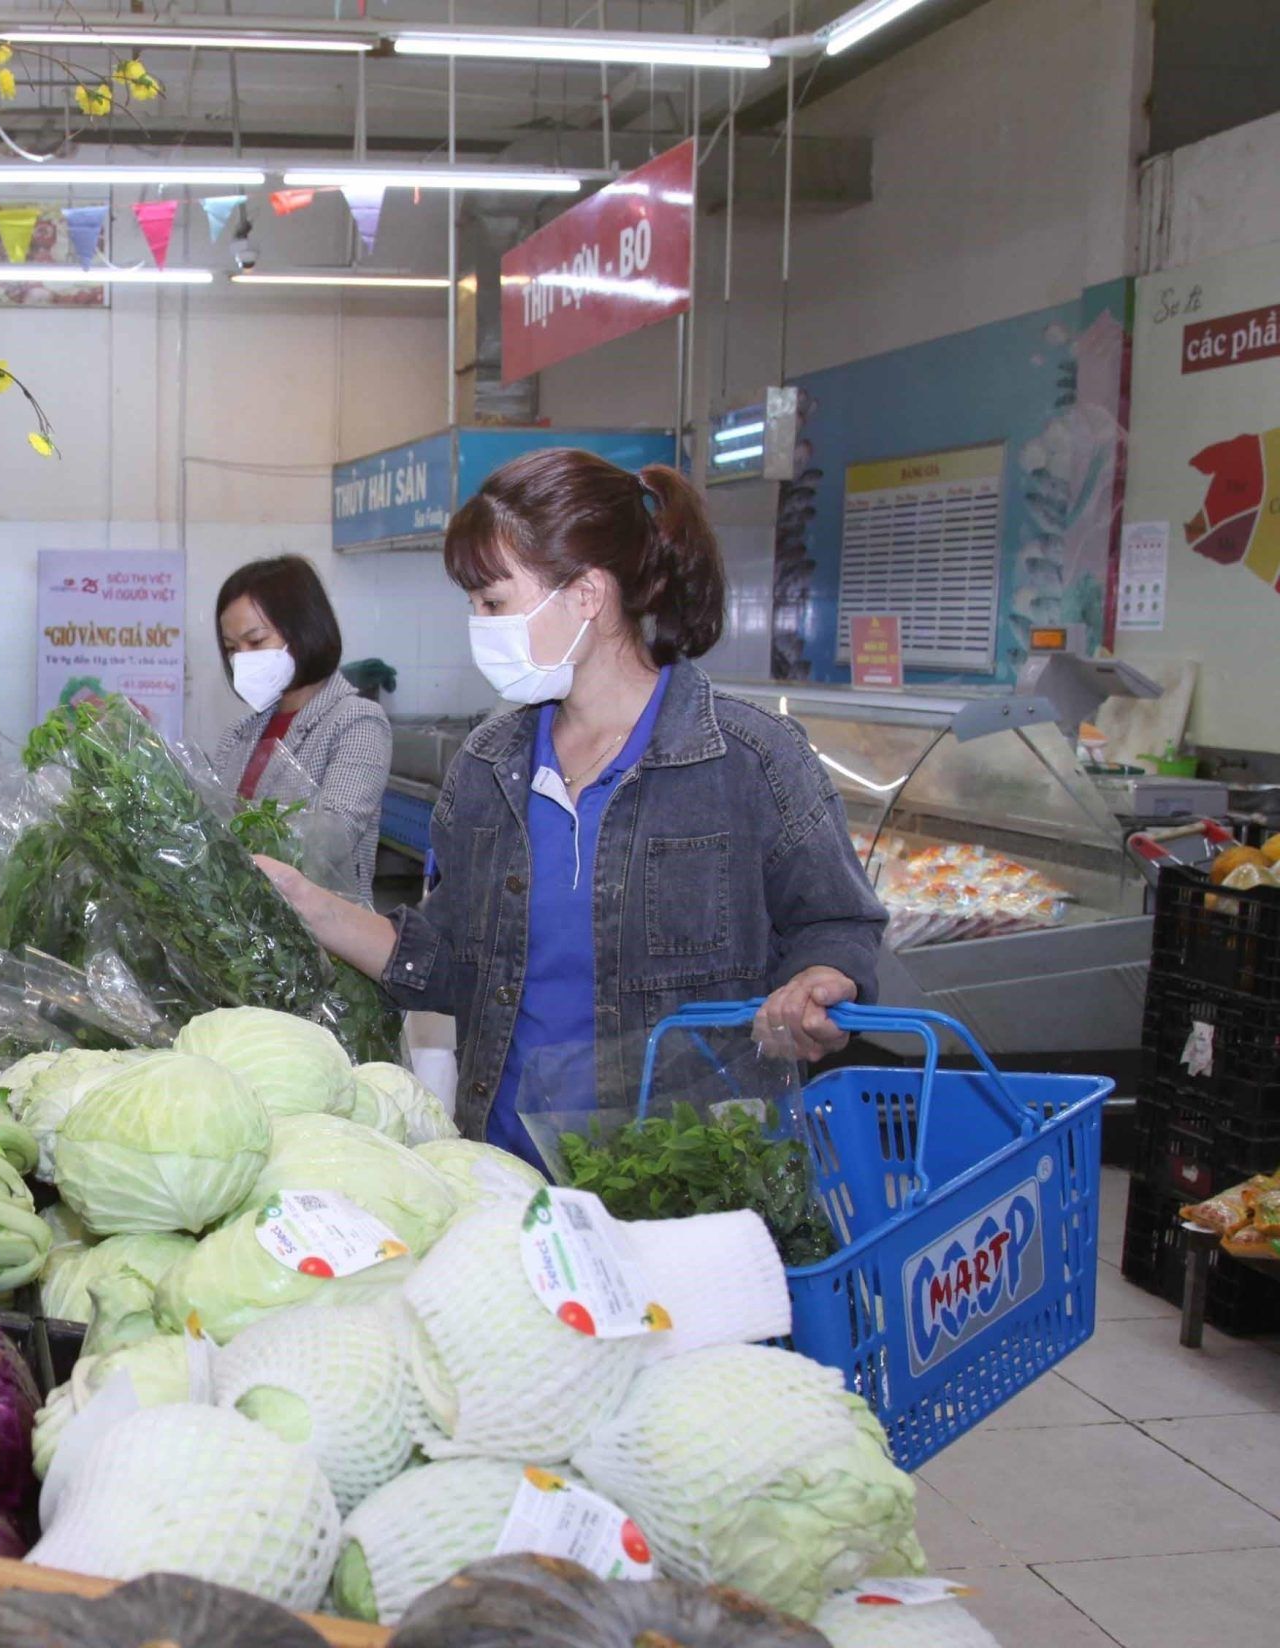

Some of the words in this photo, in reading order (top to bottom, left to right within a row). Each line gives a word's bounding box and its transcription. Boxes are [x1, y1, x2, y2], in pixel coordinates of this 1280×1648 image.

[1186, 328, 1227, 361] các
[1231, 309, 1280, 360] phầ
[395, 450, 428, 506] SẢN
[929, 1230, 1010, 1320] MART
